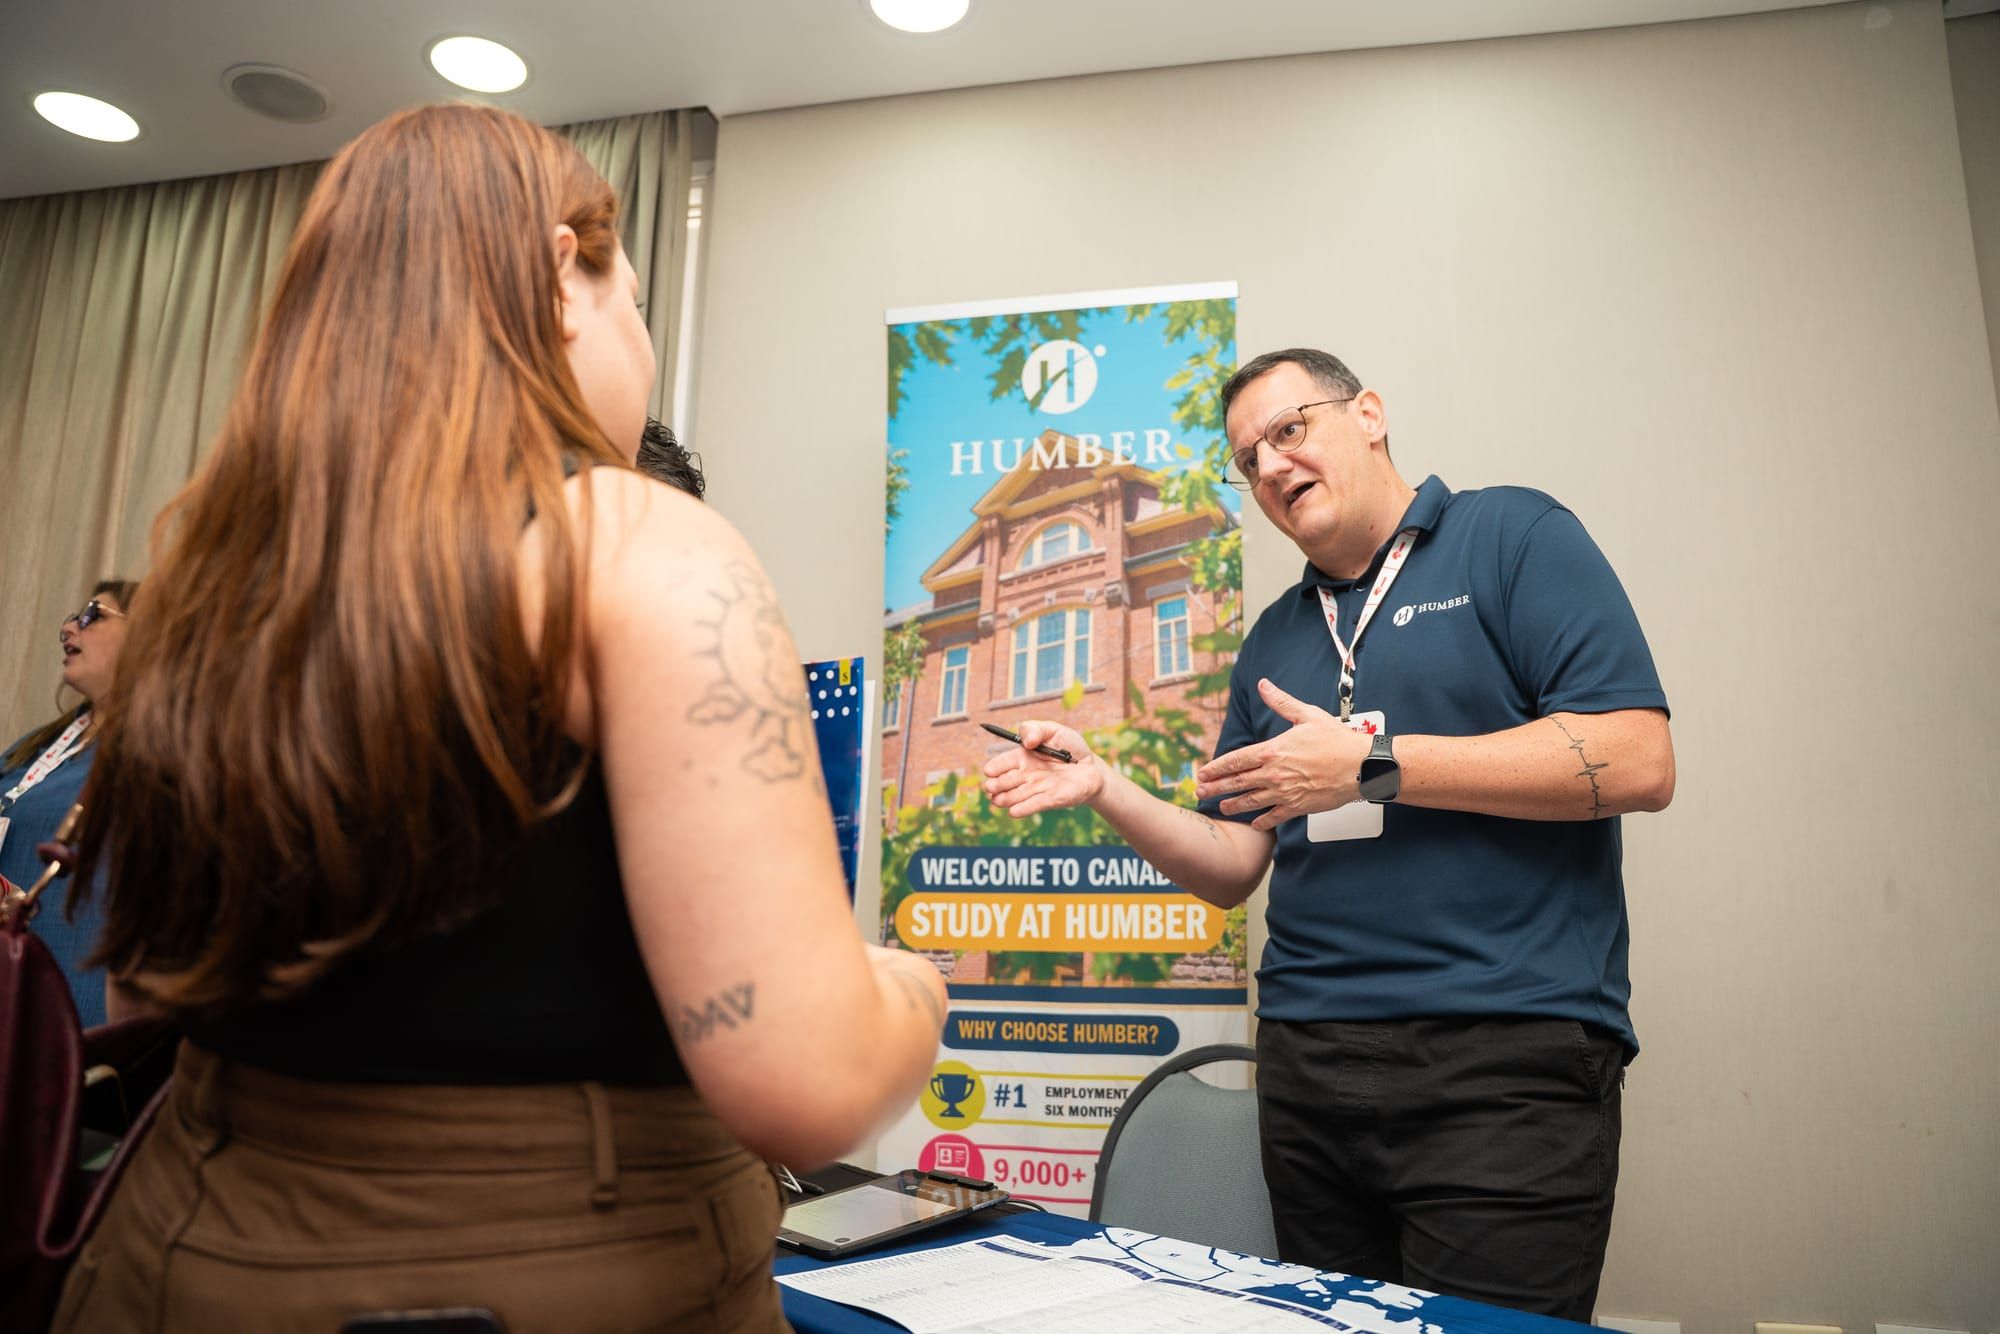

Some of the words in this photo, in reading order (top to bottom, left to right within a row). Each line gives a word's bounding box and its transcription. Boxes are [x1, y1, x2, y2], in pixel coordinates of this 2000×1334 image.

[949, 428, 1176, 477] HUMBER
[1418, 594, 1471, 614] HUMBER
[921, 857, 1044, 887] WELCOME
[1049, 858, 1080, 887] TO
[910, 902, 1011, 938] STUDY
[1018, 903, 1055, 939] AT
[1065, 904, 1208, 941] HUMBER
[958, 1020, 995, 1041] WHY
[1001, 1021, 1068, 1043] CHOOSE
[1074, 1023, 1159, 1045] HUMBER?
[993, 1083, 1027, 1109] #1
[1045, 1086, 1129, 1100] EMPLOYMENT
[1045, 1104, 1064, 1117] SIX
[1068, 1105, 1120, 1118] MONTHS
[993, 1158, 1086, 1188] 9,000+
